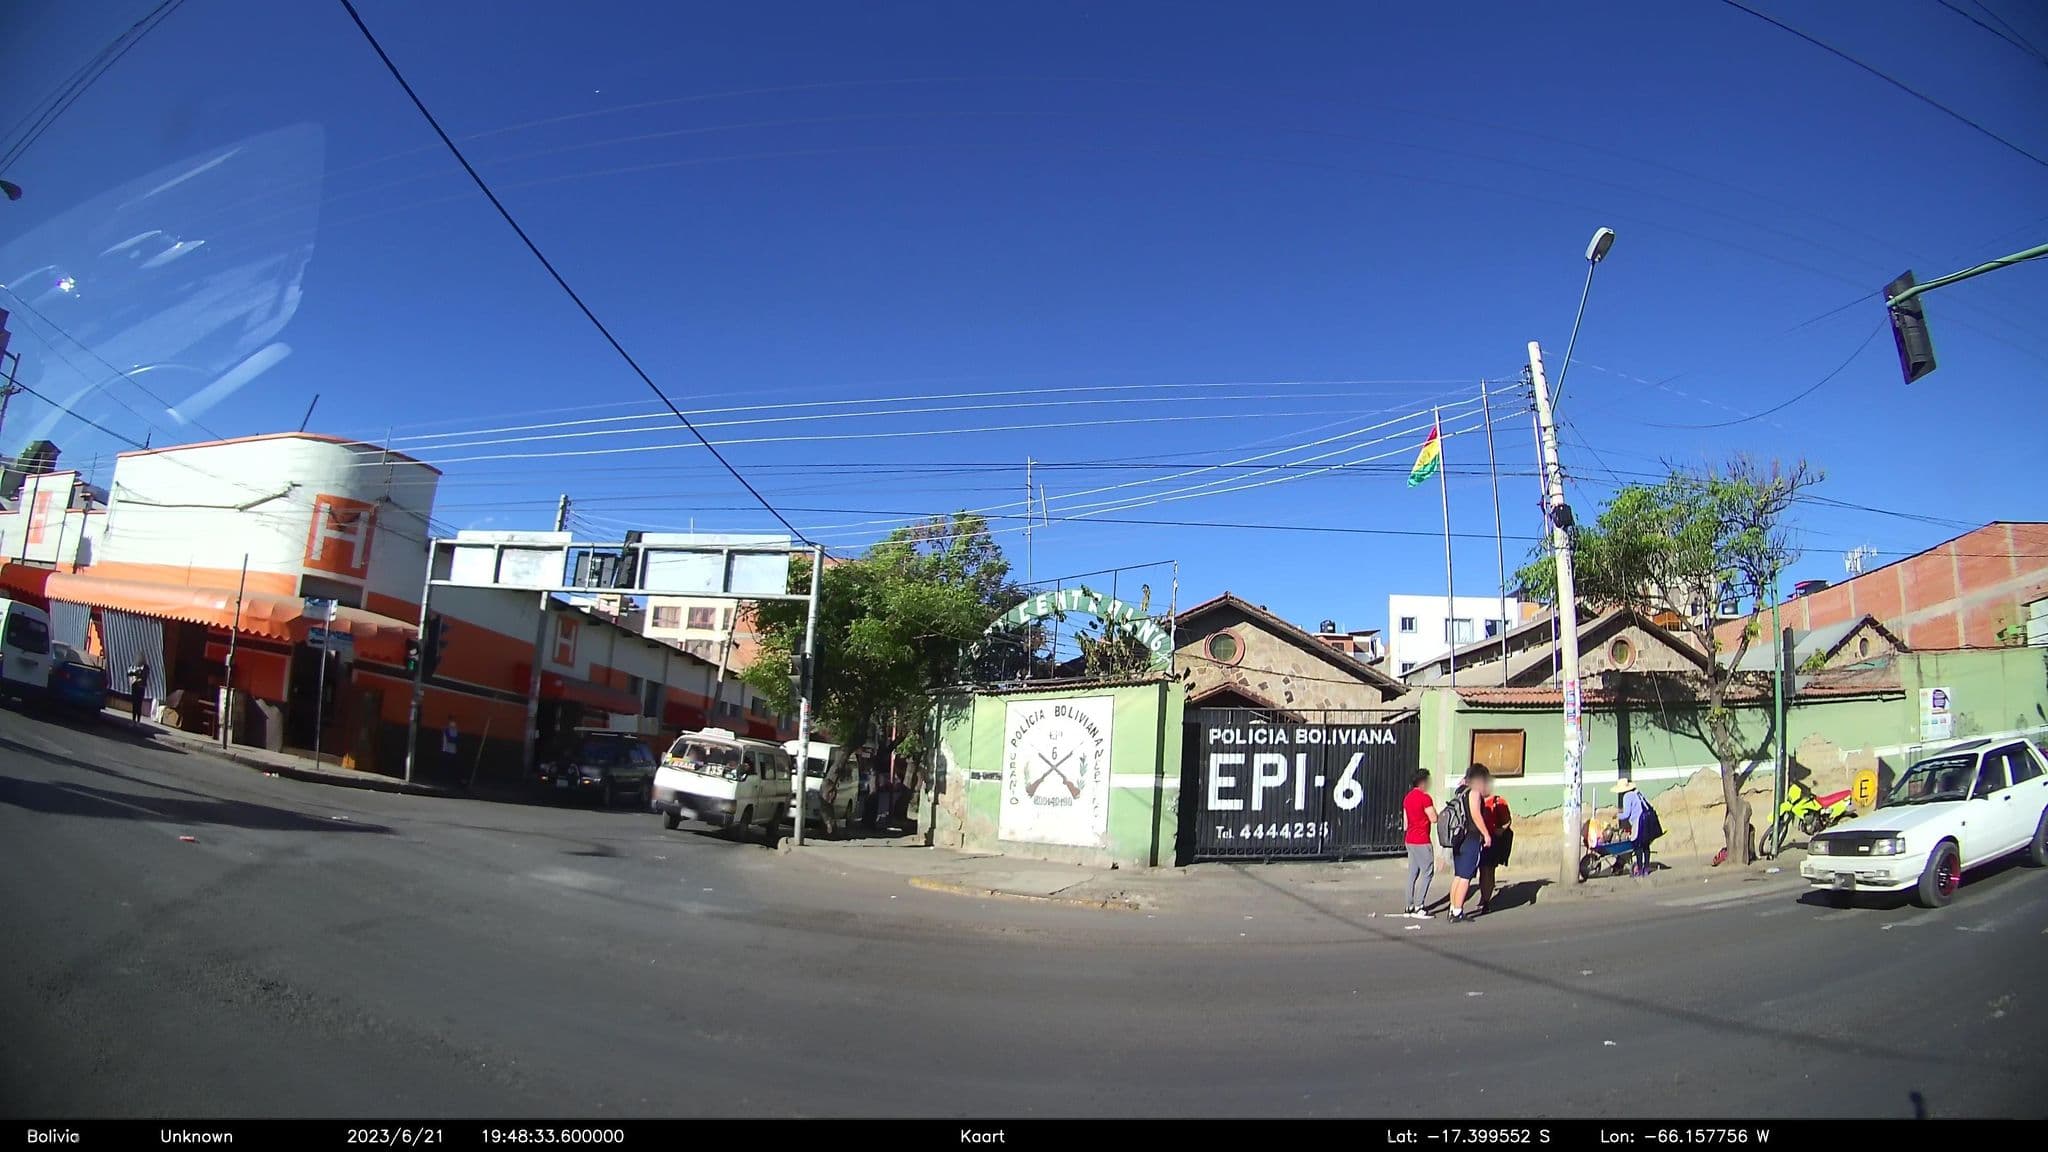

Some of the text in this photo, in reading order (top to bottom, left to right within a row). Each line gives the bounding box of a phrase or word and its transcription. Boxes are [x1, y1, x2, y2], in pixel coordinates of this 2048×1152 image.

[311, 502, 370, 569] H
[1011, 705, 1104, 748] POLICIA BOLIVIANA
[1209, 727, 1396, 745] POLICIA BOLIVIANA
[1859, 779, 1870, 799] E
